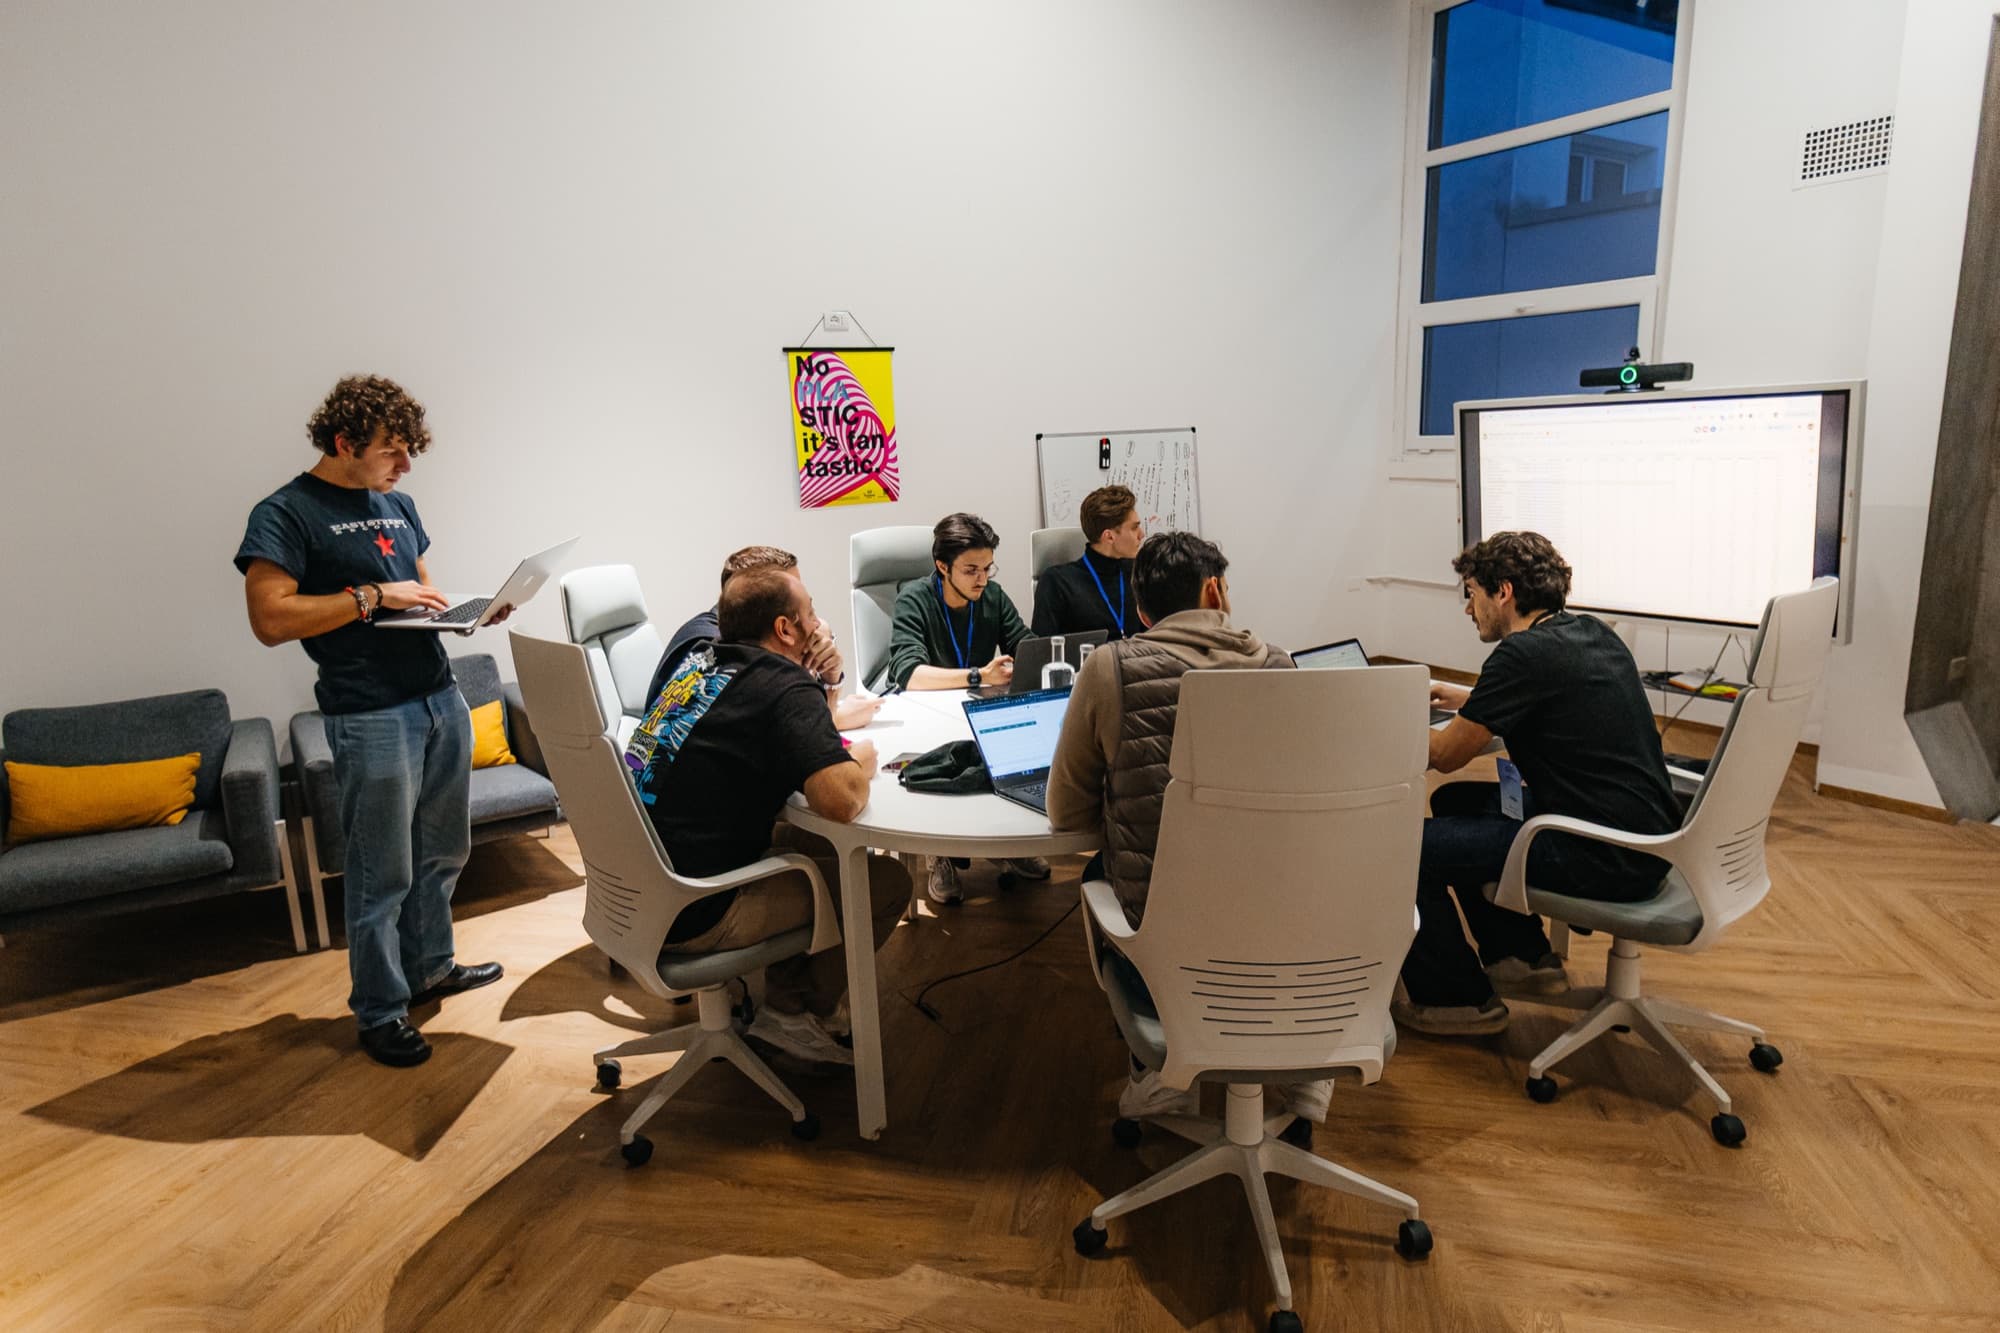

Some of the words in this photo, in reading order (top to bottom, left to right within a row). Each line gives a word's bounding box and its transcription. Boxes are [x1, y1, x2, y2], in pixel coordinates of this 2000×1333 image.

[796, 355, 830, 376] No
[798, 381, 850, 402] PLA
[800, 405, 859, 427] STIC
[803, 432, 839, 452] it's
[848, 430, 884, 450] fan
[804, 455, 881, 477] tastic.
